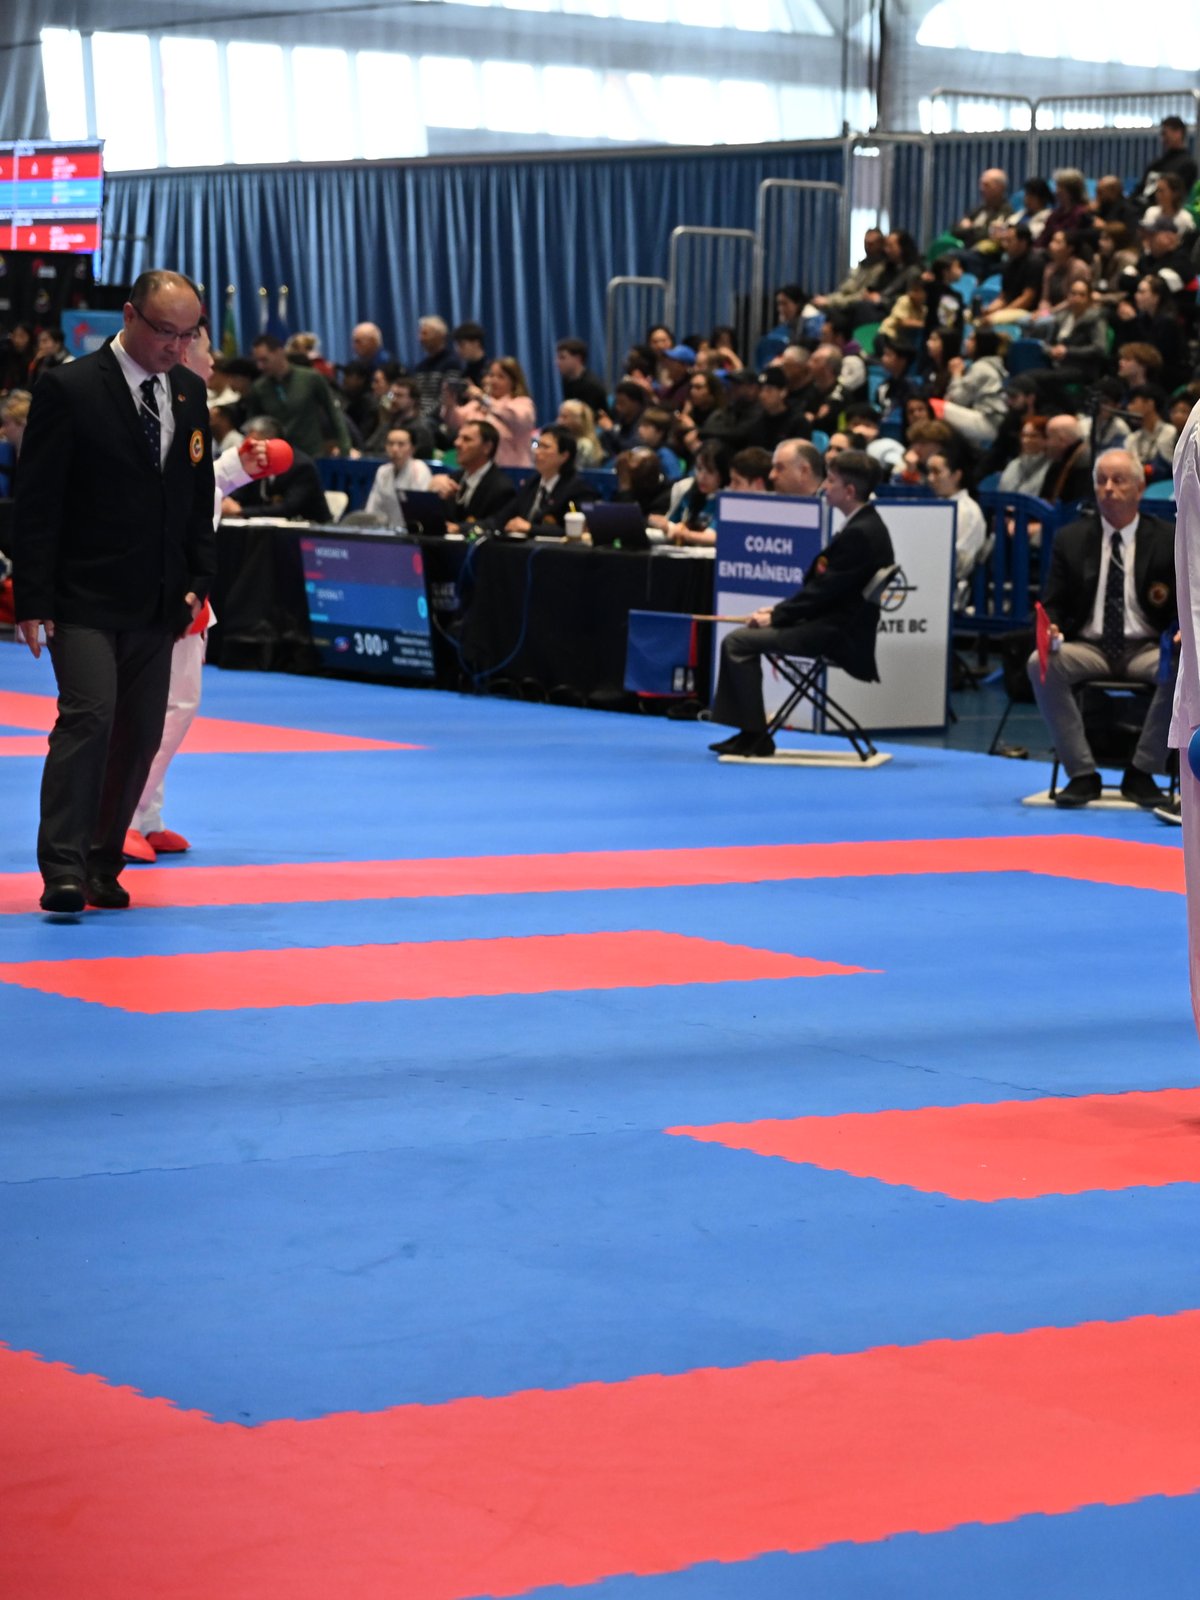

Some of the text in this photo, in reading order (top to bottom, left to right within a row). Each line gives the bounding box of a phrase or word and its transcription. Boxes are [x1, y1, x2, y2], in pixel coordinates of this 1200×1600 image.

[745, 535, 793, 555] COACH
[718, 560, 804, 585] ENTRAÎNEUR
[878, 619, 927, 634] ATE BC
